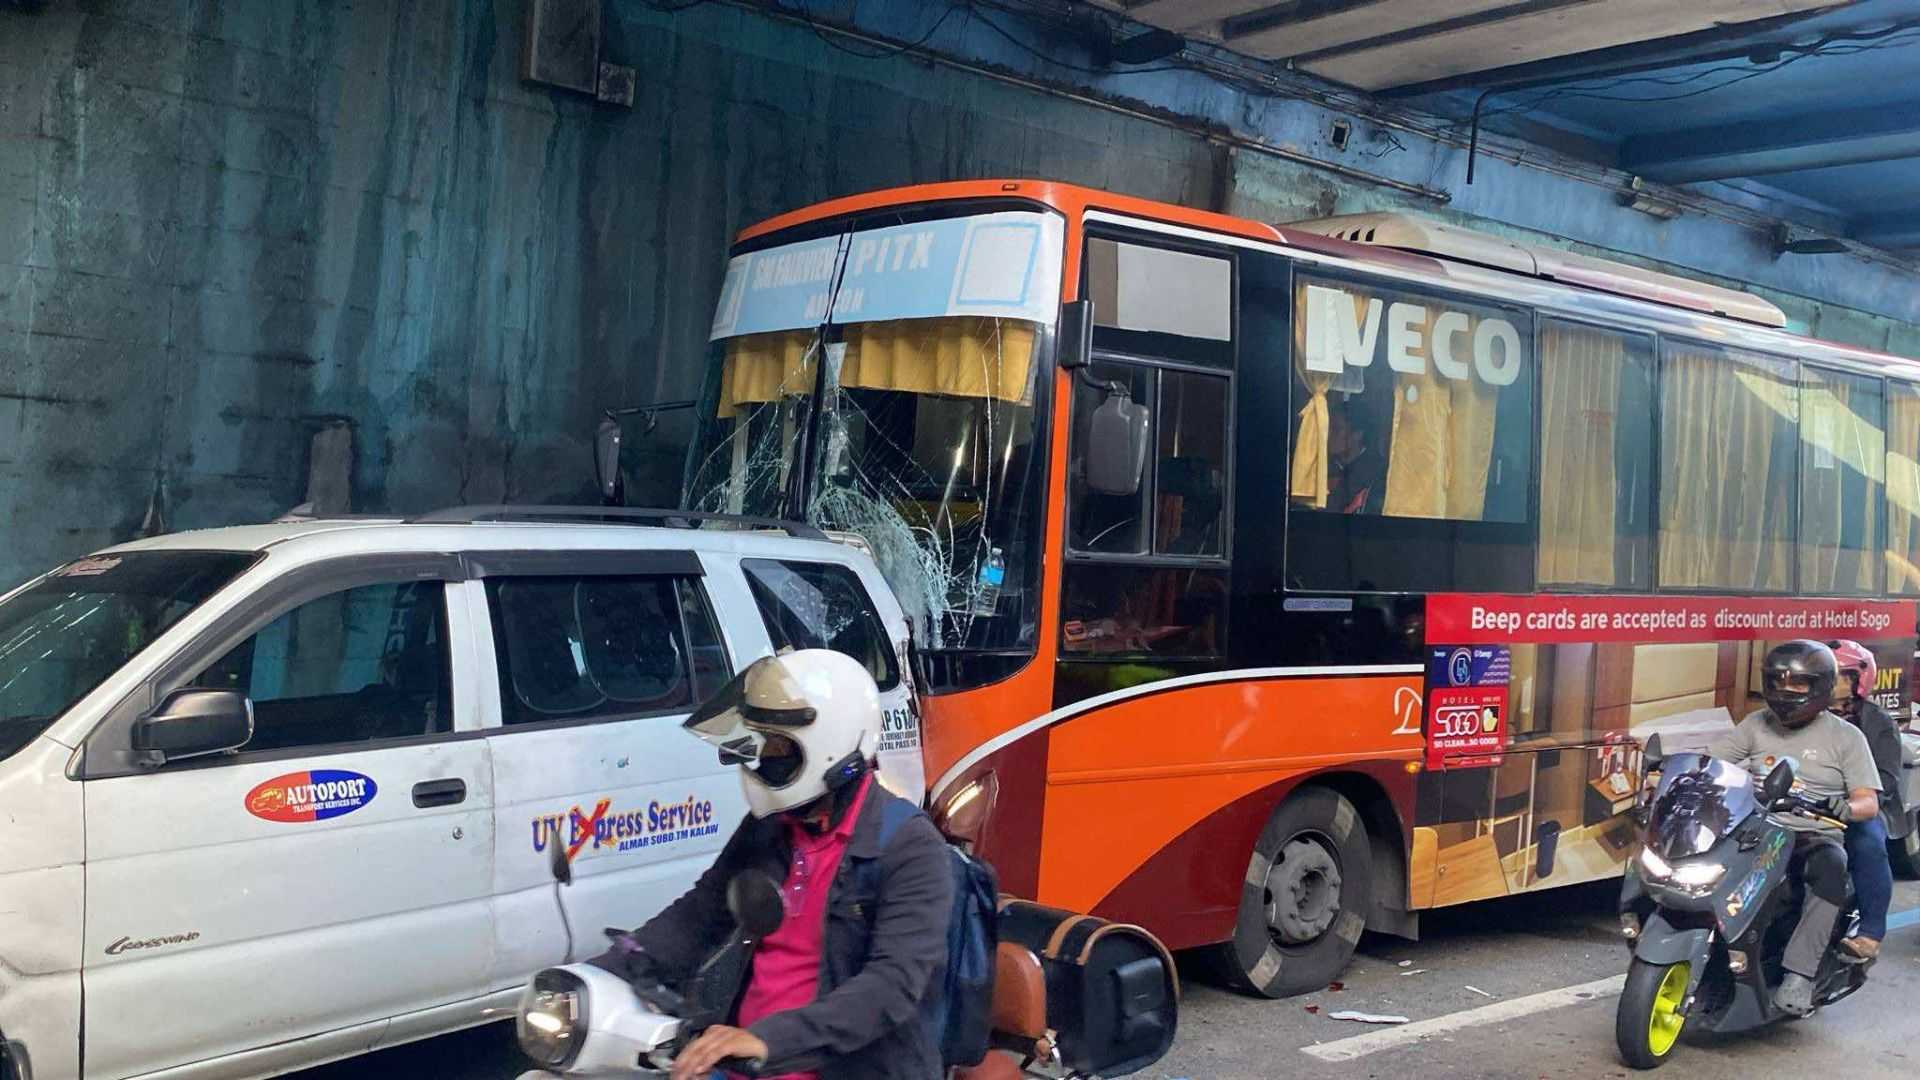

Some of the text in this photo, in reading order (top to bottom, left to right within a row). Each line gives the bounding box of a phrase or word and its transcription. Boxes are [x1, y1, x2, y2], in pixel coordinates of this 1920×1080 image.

[854, 231, 935, 274] PITX
[1471, 607, 1890, 634] Beep cards are accepted as discount card at Hotel Sogo
[1433, 705, 1480, 737] SOGO
[286, 778, 367, 806] AUTOPORT
[292, 802, 325, 813] TRANSPORT
[325, 799, 351, 809] SERVICES
[647, 795, 712, 832] Service
[618, 837, 650, 852] ALMAR
[690, 823, 719, 839] KALAW
